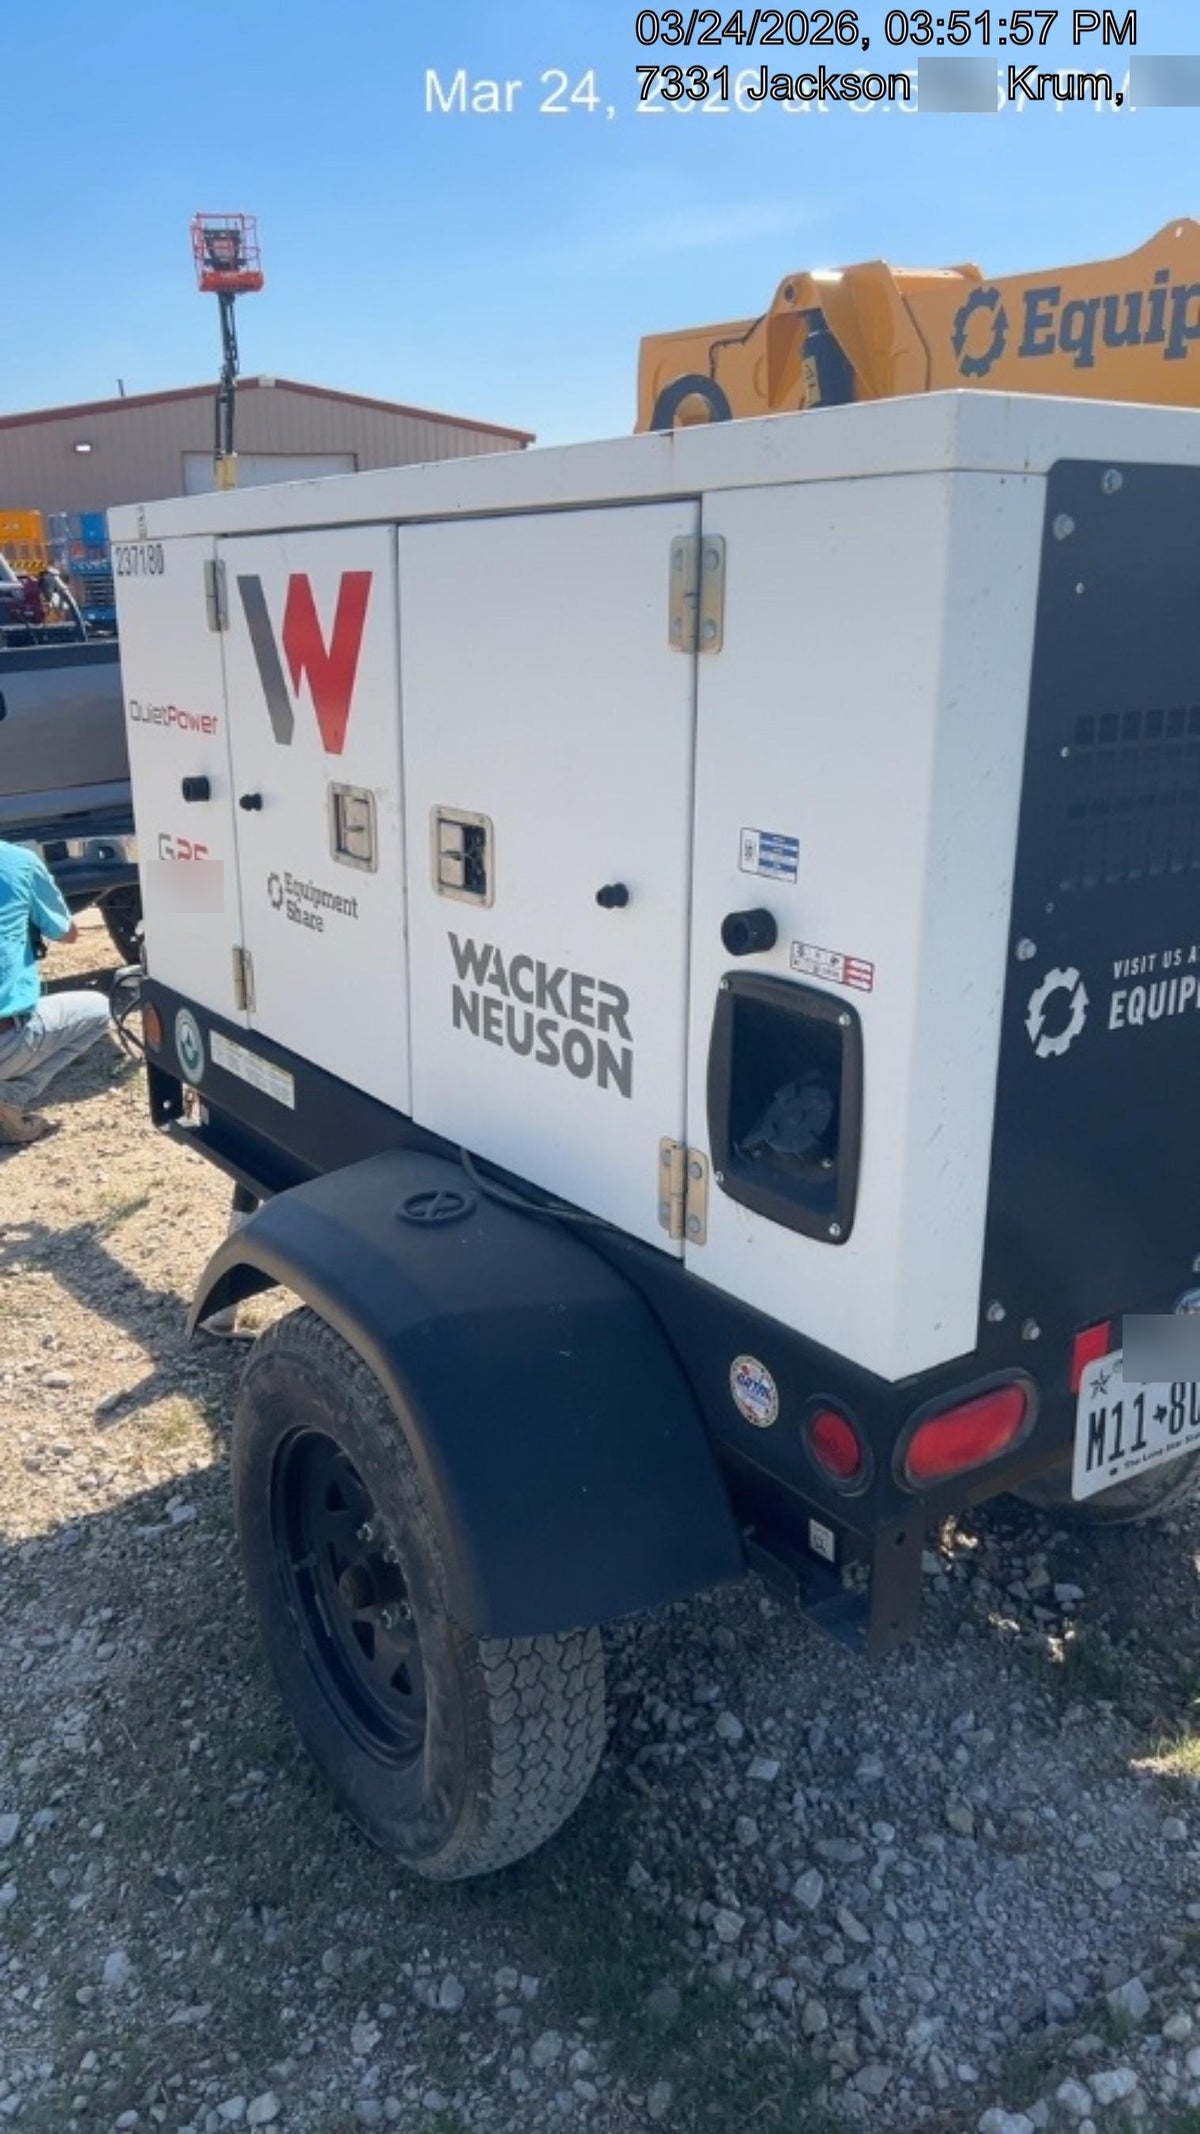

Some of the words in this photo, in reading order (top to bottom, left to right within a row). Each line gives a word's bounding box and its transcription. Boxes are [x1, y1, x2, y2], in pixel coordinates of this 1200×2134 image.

[1018, 269, 1200, 369] Equip
[129, 699, 218, 736] QuietPower
[284, 872, 358, 921] Equipment
[286, 899, 324, 933] Share
[447, 931, 634, 1043] WACKER
[1113, 953, 1157, 980] VISIT
[1162, 948, 1182, 968] US
[1187, 945, 1200, 964] A
[1108, 974, 1200, 1030] EQUIP
[452, 983, 634, 1100] NEUSON
